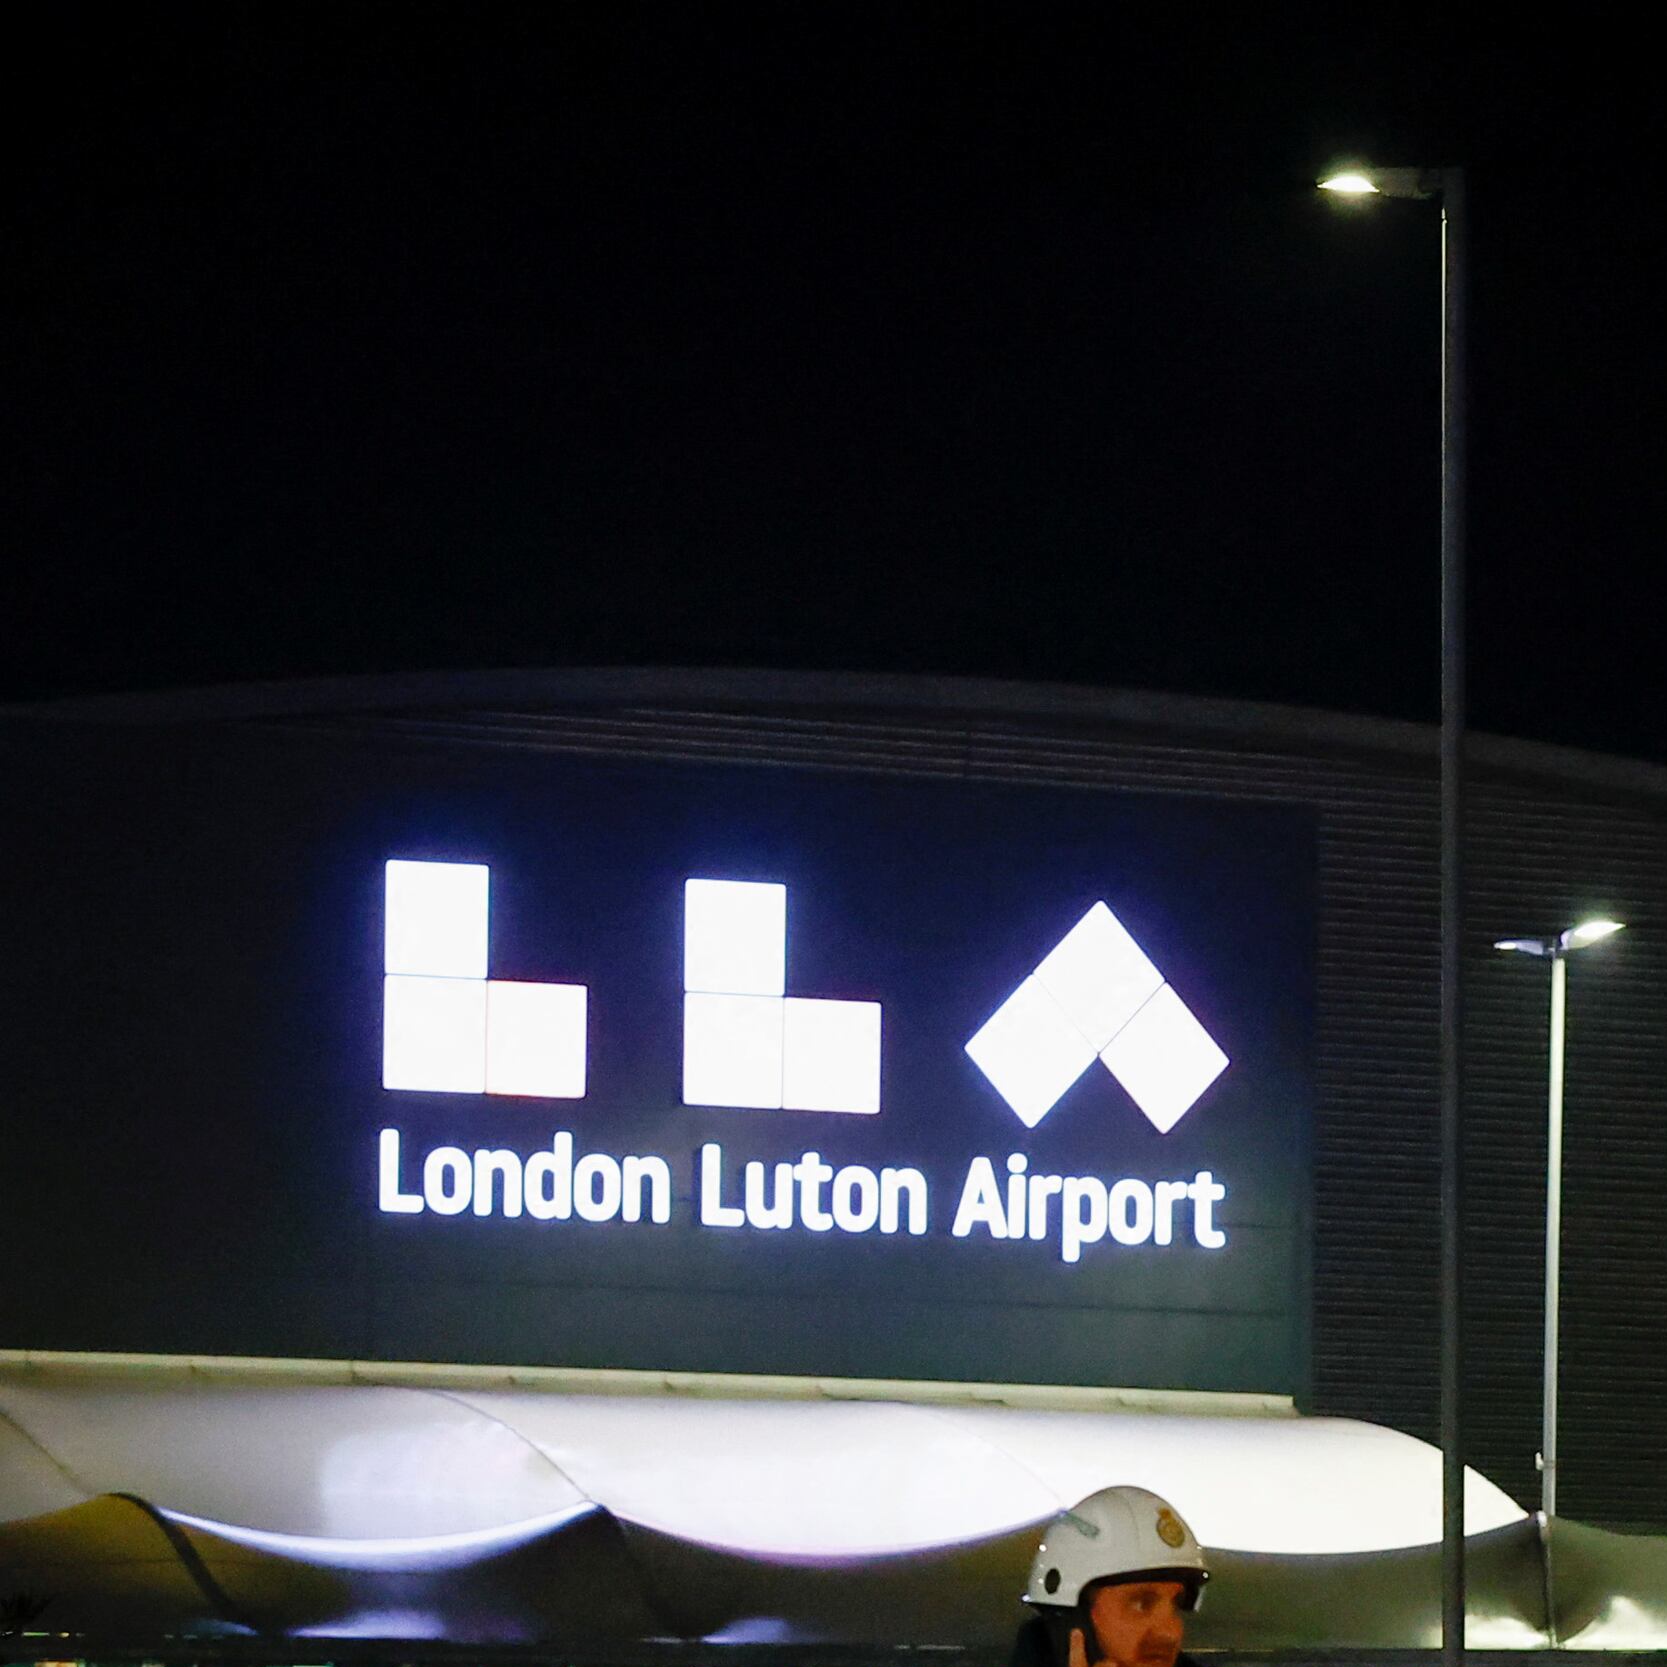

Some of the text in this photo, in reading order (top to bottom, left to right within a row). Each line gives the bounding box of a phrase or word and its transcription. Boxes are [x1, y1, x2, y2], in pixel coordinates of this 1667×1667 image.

[379, 1128, 1227, 1263] London Luton Airport
